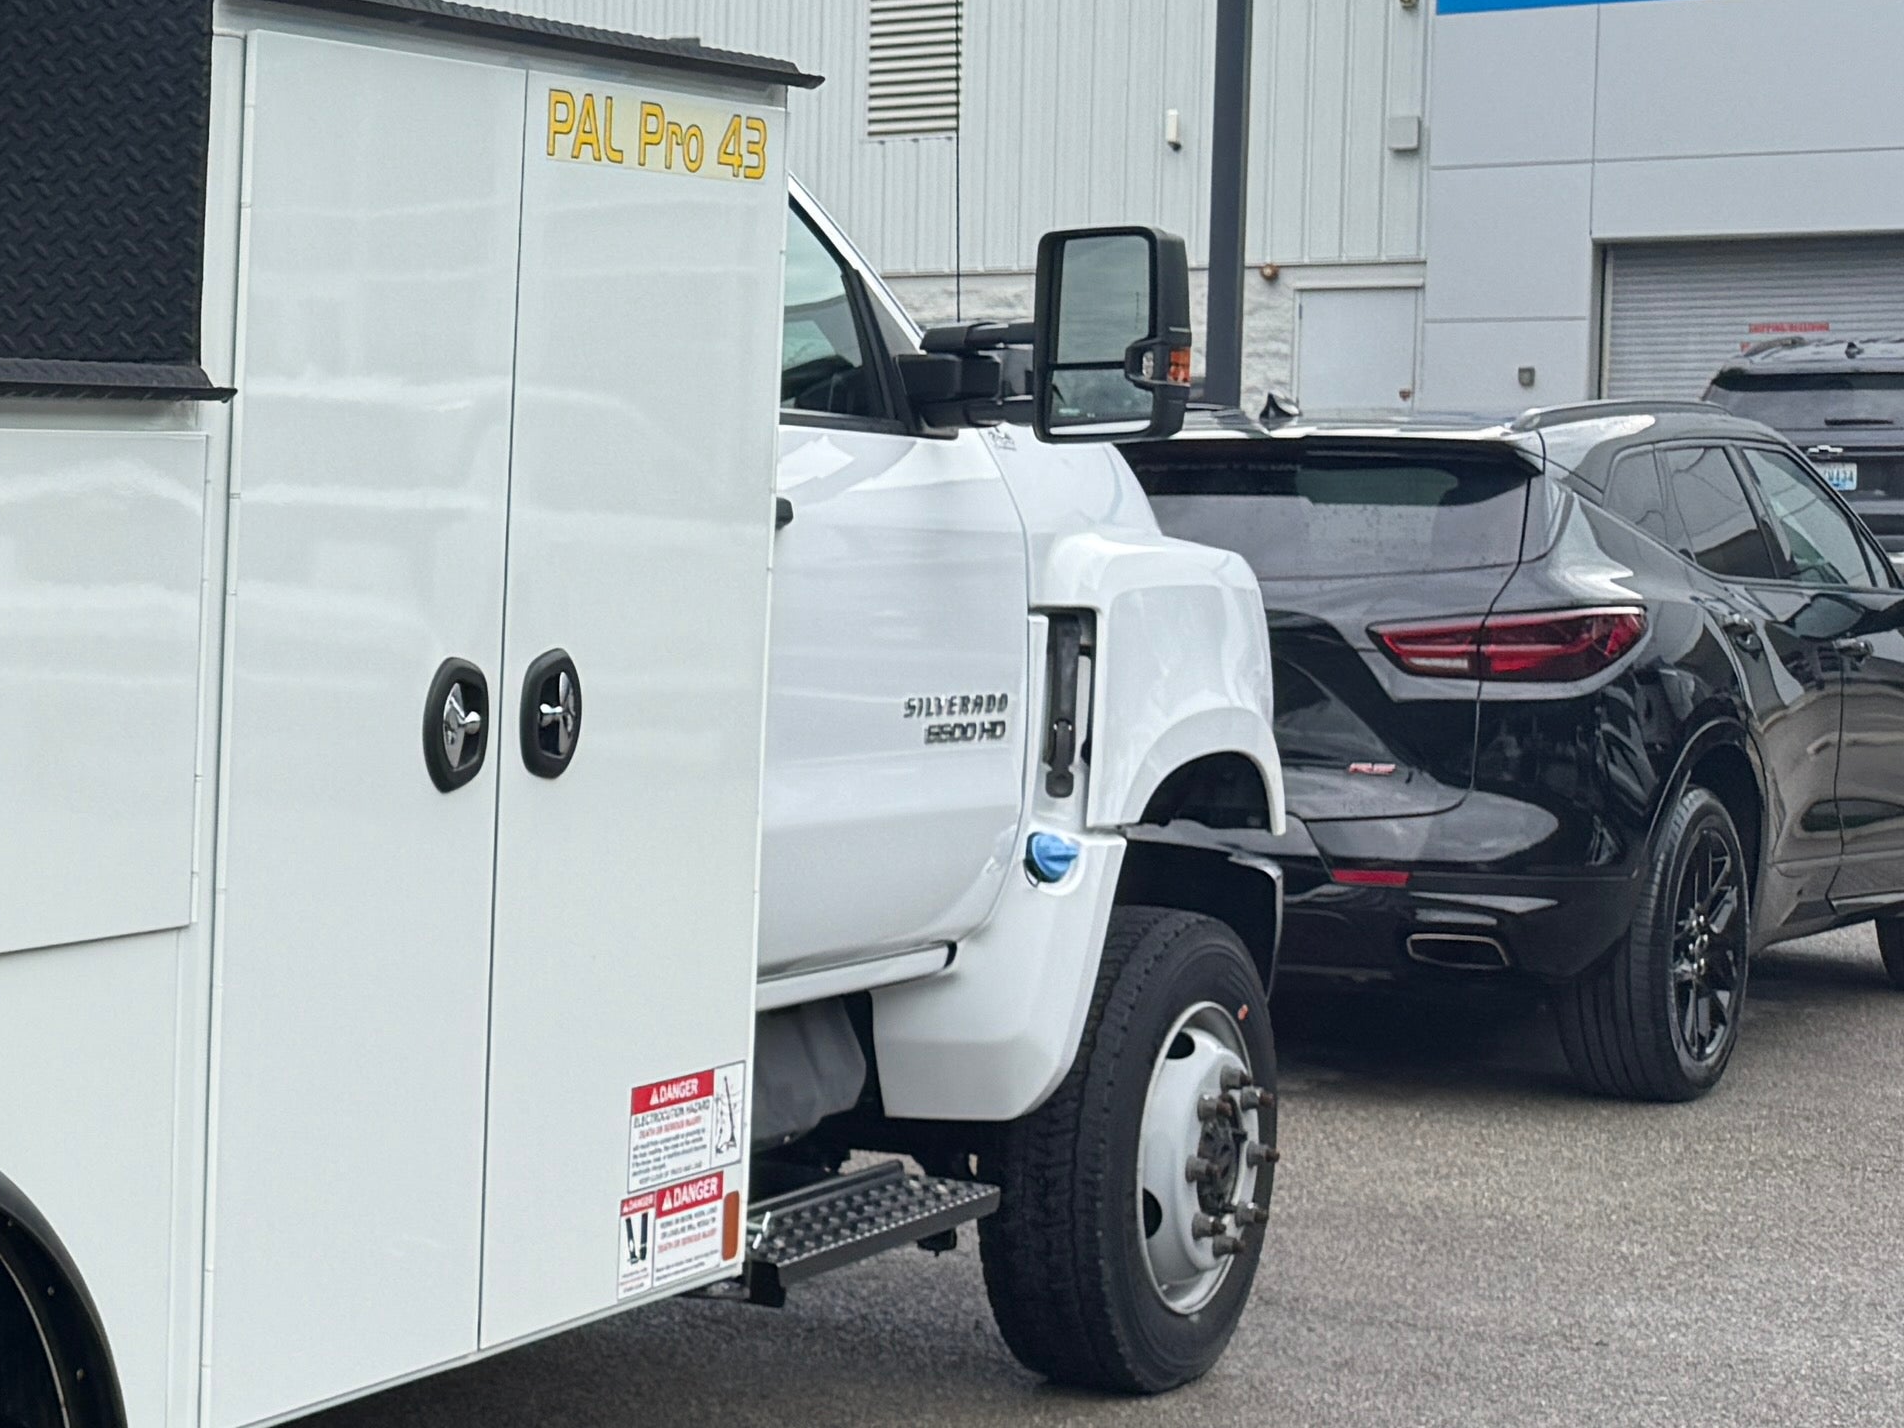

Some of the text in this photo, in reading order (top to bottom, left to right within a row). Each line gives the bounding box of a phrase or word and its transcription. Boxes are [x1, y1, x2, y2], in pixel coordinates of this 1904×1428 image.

[547, 89, 768, 180] PAL Pro 43
[903, 693, 1009, 718] SILVERADO
[660, 1078, 699, 1104] DANGER
[673, 1176, 718, 1208] DANGER
